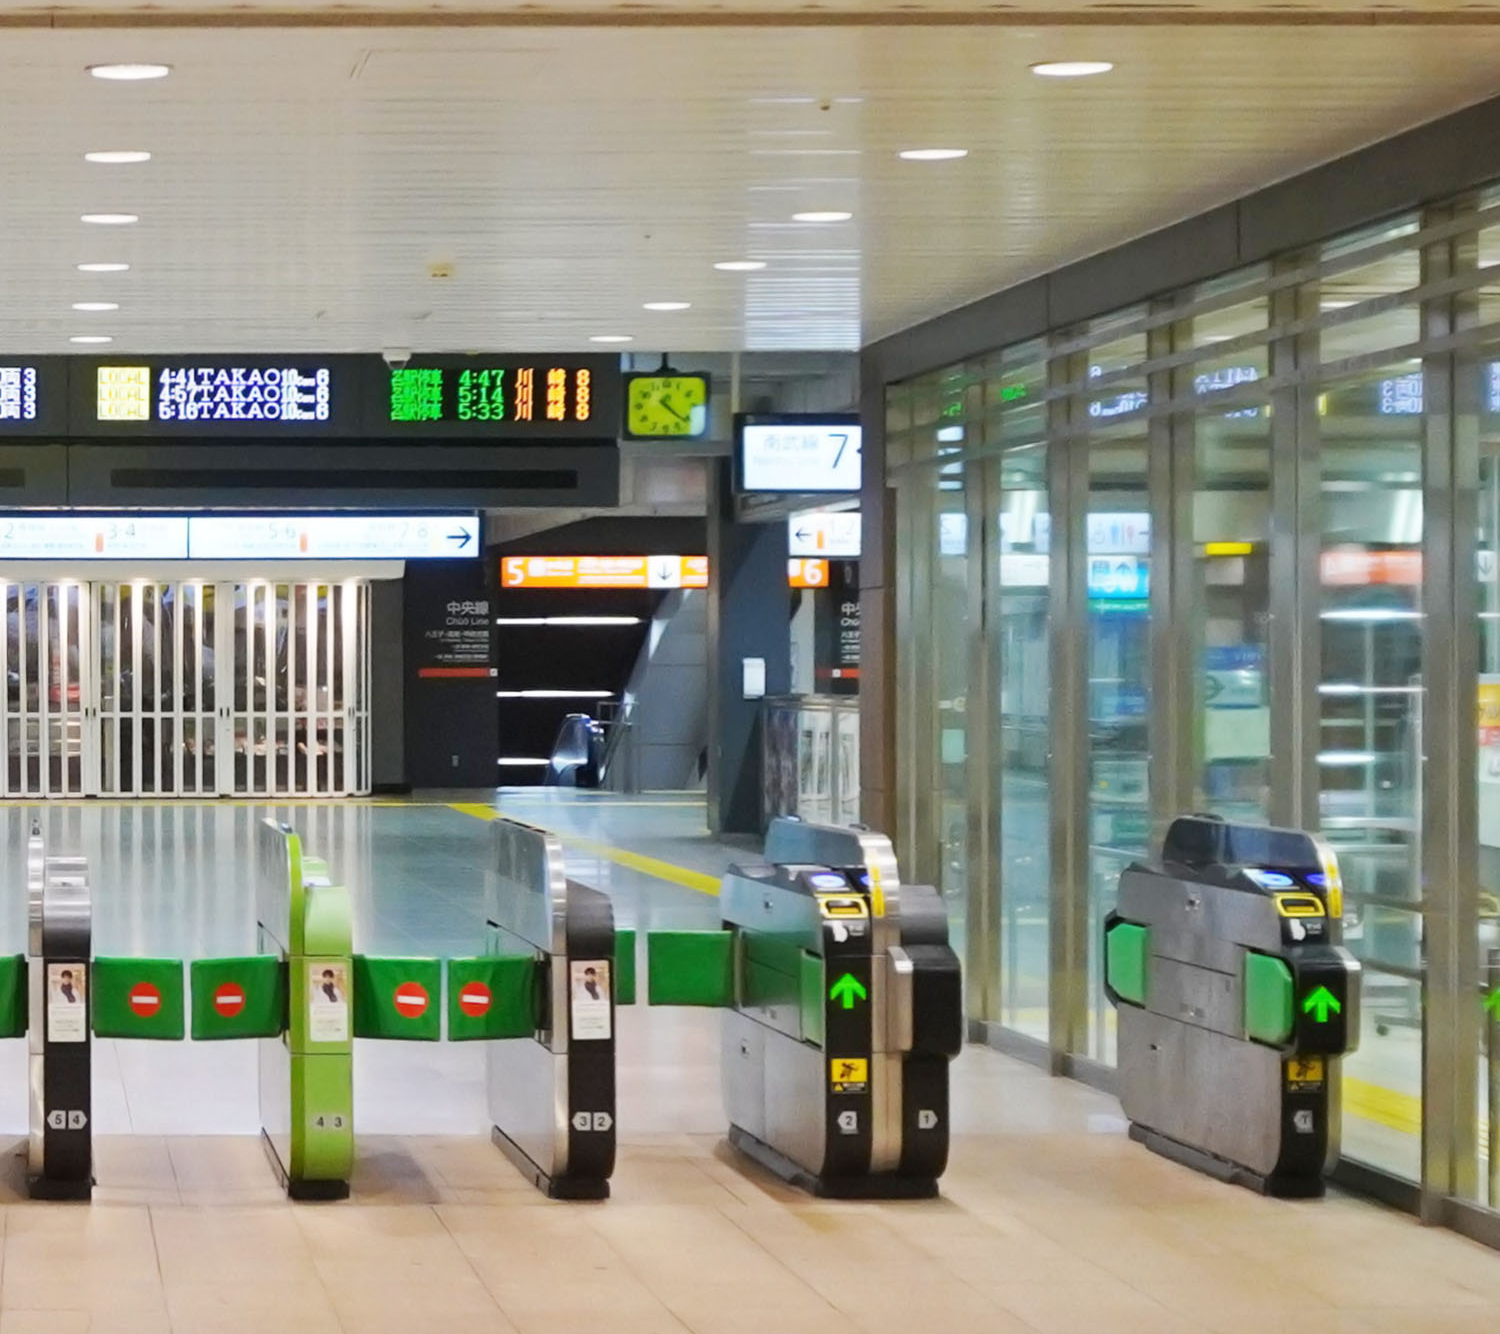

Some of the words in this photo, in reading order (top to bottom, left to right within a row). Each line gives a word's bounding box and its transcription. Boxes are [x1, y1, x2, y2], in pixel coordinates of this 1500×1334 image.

[23, 367, 36, 384] 3
[160, 369, 197, 385] 4:41
[198, 369, 281, 385] TAKAO
[316, 369, 330, 385] 6
[459, 369, 504, 386] 4:47
[576, 369, 590, 386] 8
[23, 384, 36, 401] 3
[160, 386, 197, 402] 4:57
[198, 386, 281, 402] TAKAO
[316, 386, 330, 402] 6
[459, 386, 504, 403] 5:14
[576, 386, 590, 403] 8
[23, 401, 36, 418] 3
[198, 402, 281, 419] TAKAO
[316, 402, 330, 419] 6
[459, 403, 504, 421] 5:33
[576, 403, 590, 421] 8
[828, 433, 848, 469] 7
[507, 559, 525, 586] 5
[803, 559, 823, 585] 6
[446, 601, 490, 616] 中央線
[54, 1114, 63, 1126] 5
[72, 1114, 81, 1126] 4
[316, 1116, 324, 1127] 4
[334, 1116, 342, 1127] 3
[578, 1114, 587, 1127] 3
[596, 1114, 606, 1127] 2
[844, 1114, 853, 1127] 2
[923, 1112, 931, 1124] 1
